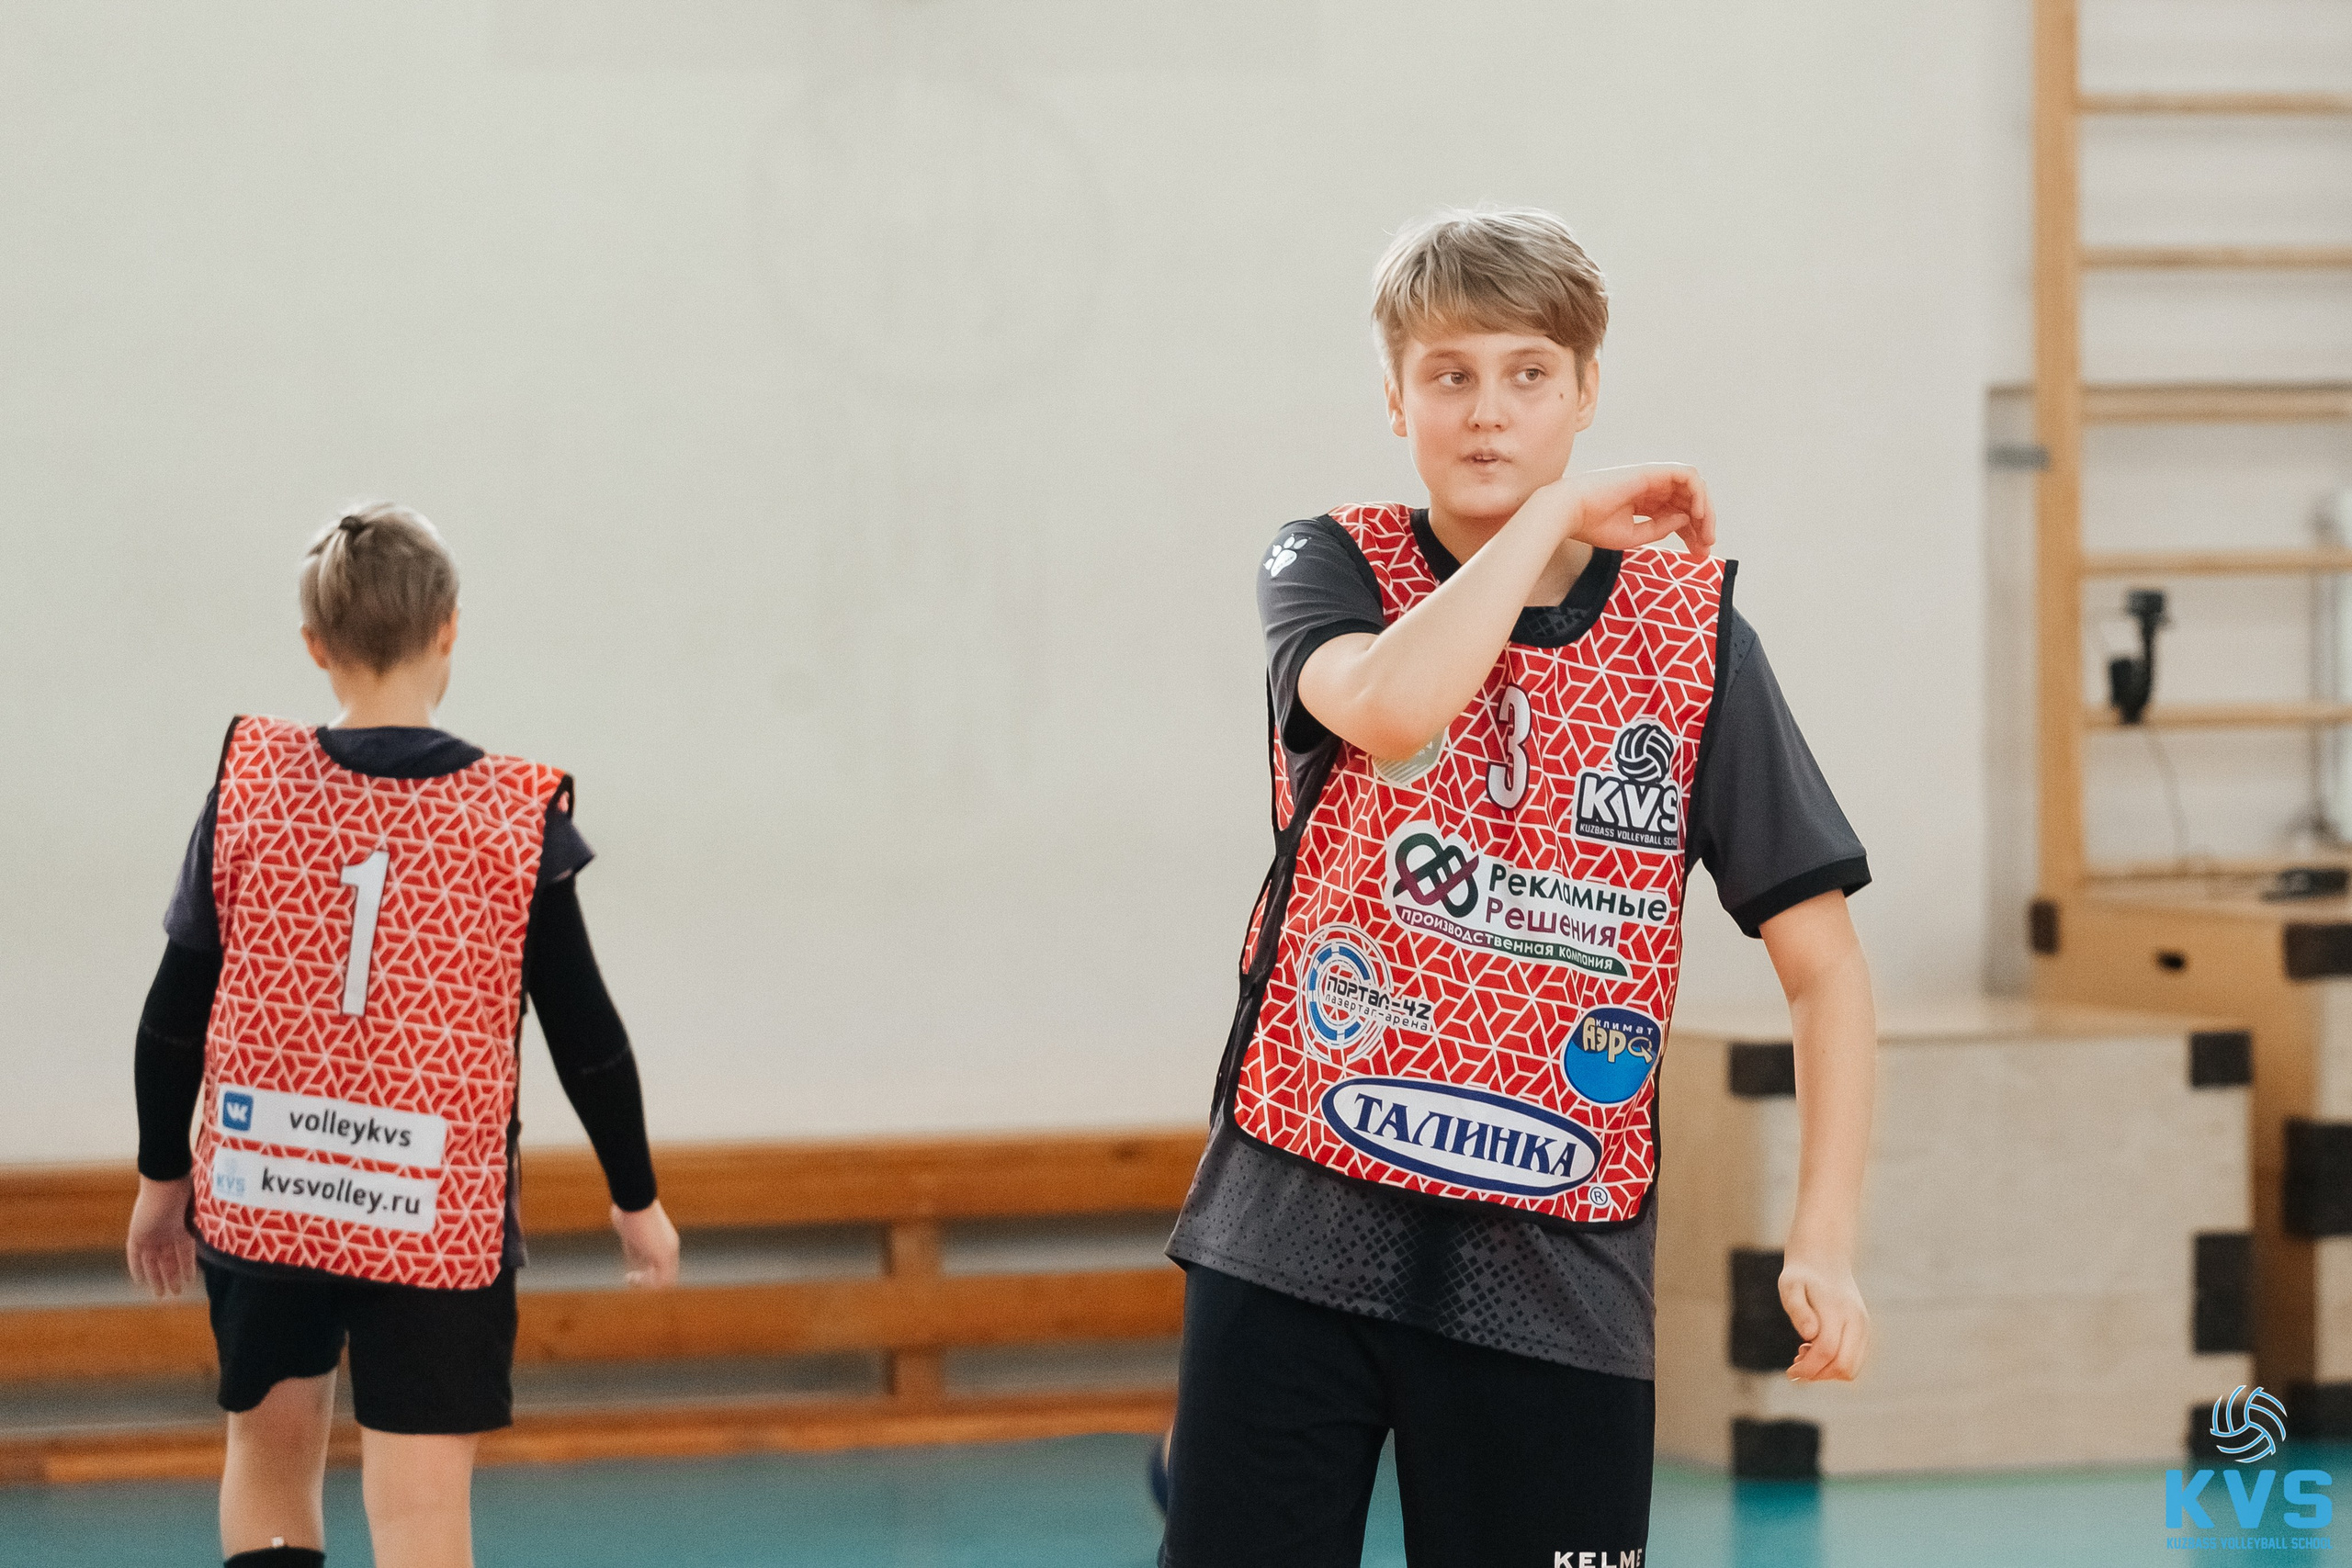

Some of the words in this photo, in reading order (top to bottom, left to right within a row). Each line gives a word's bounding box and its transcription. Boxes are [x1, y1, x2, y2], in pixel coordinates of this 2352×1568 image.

[1487, 682, 1532, 810] 3
[1580, 775, 1679, 832] KVS
[1579, 823, 1615, 838] KUZBASS
[1616, 829, 1662, 845] VOLLEYBALL
[1488, 863, 1668, 921] Рекламные
[340, 850, 390, 1017] 1
[1401, 908, 1555, 957] производственная
[1559, 946, 1613, 971] компания
[1486, 897, 1617, 949] Решения
[1596, 1019, 1654, 1035] климат
[289, 1109, 412, 1147] volleykvs
[1353, 1092, 1577, 1178] ТАЛИНКА
[262, 1167, 420, 1214] kvsvolley.ru
